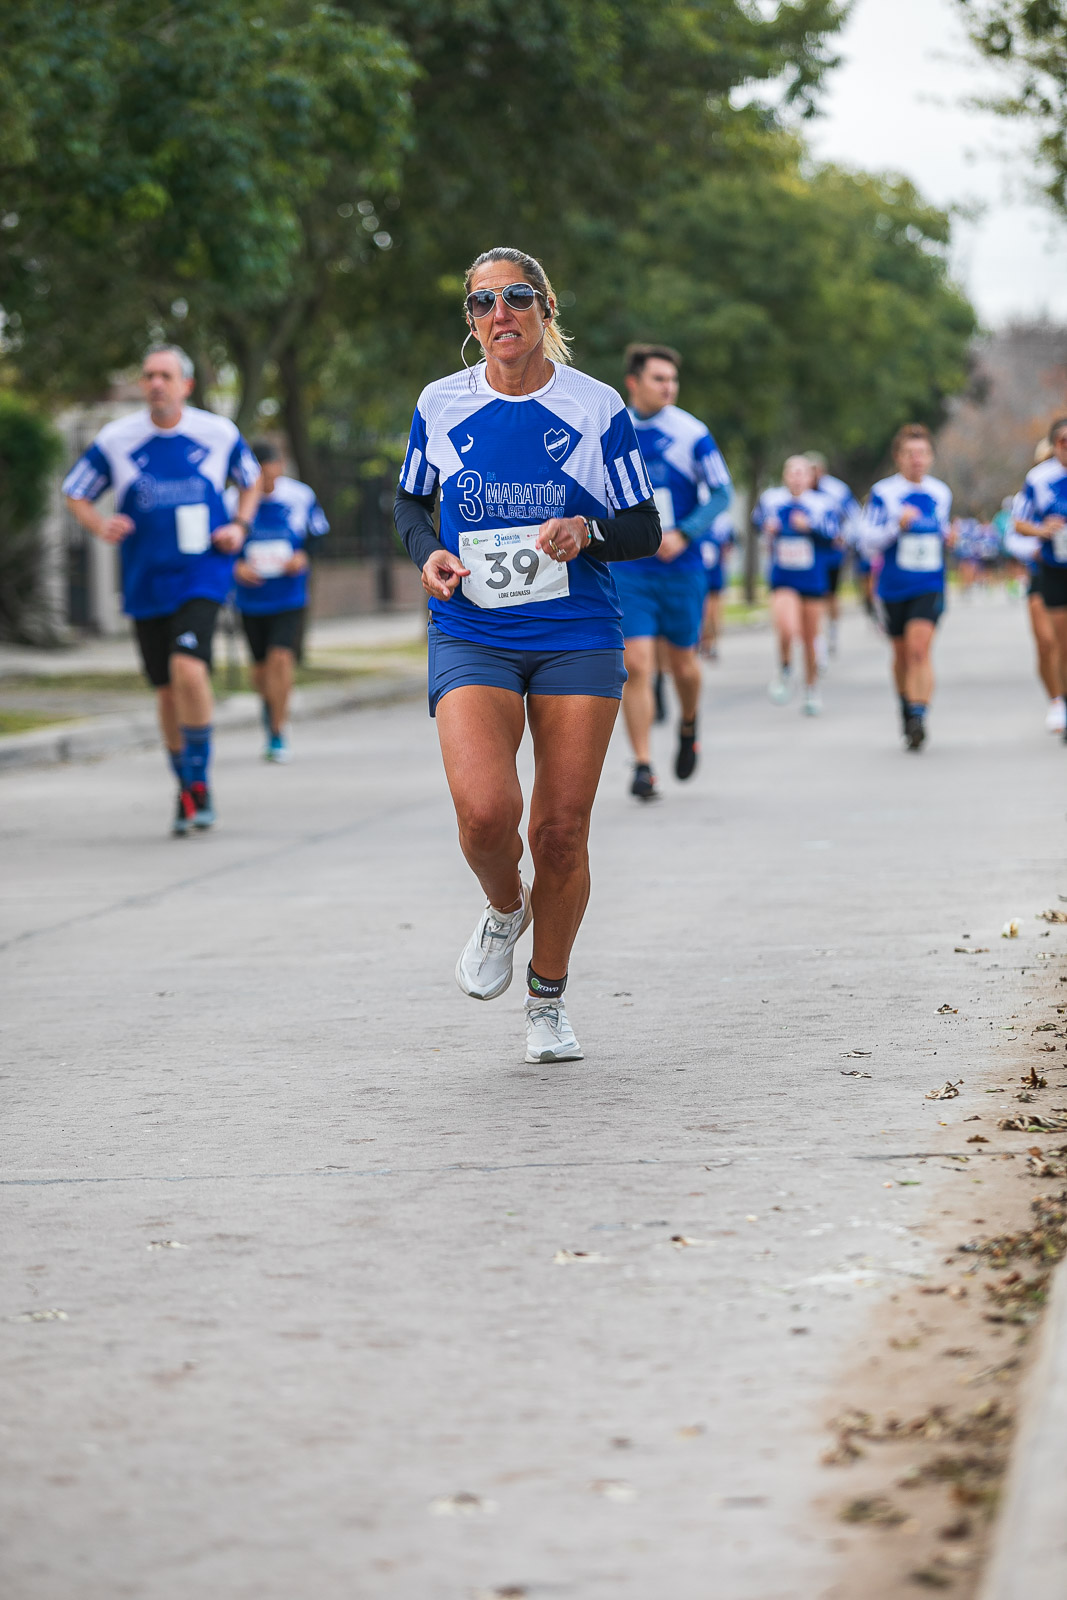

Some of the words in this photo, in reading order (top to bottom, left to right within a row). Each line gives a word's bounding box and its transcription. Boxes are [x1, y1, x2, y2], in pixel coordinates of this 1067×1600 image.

[457, 470, 484, 522] 3
[485, 480, 566, 506] MARATÓN
[484, 548, 540, 590] 39
